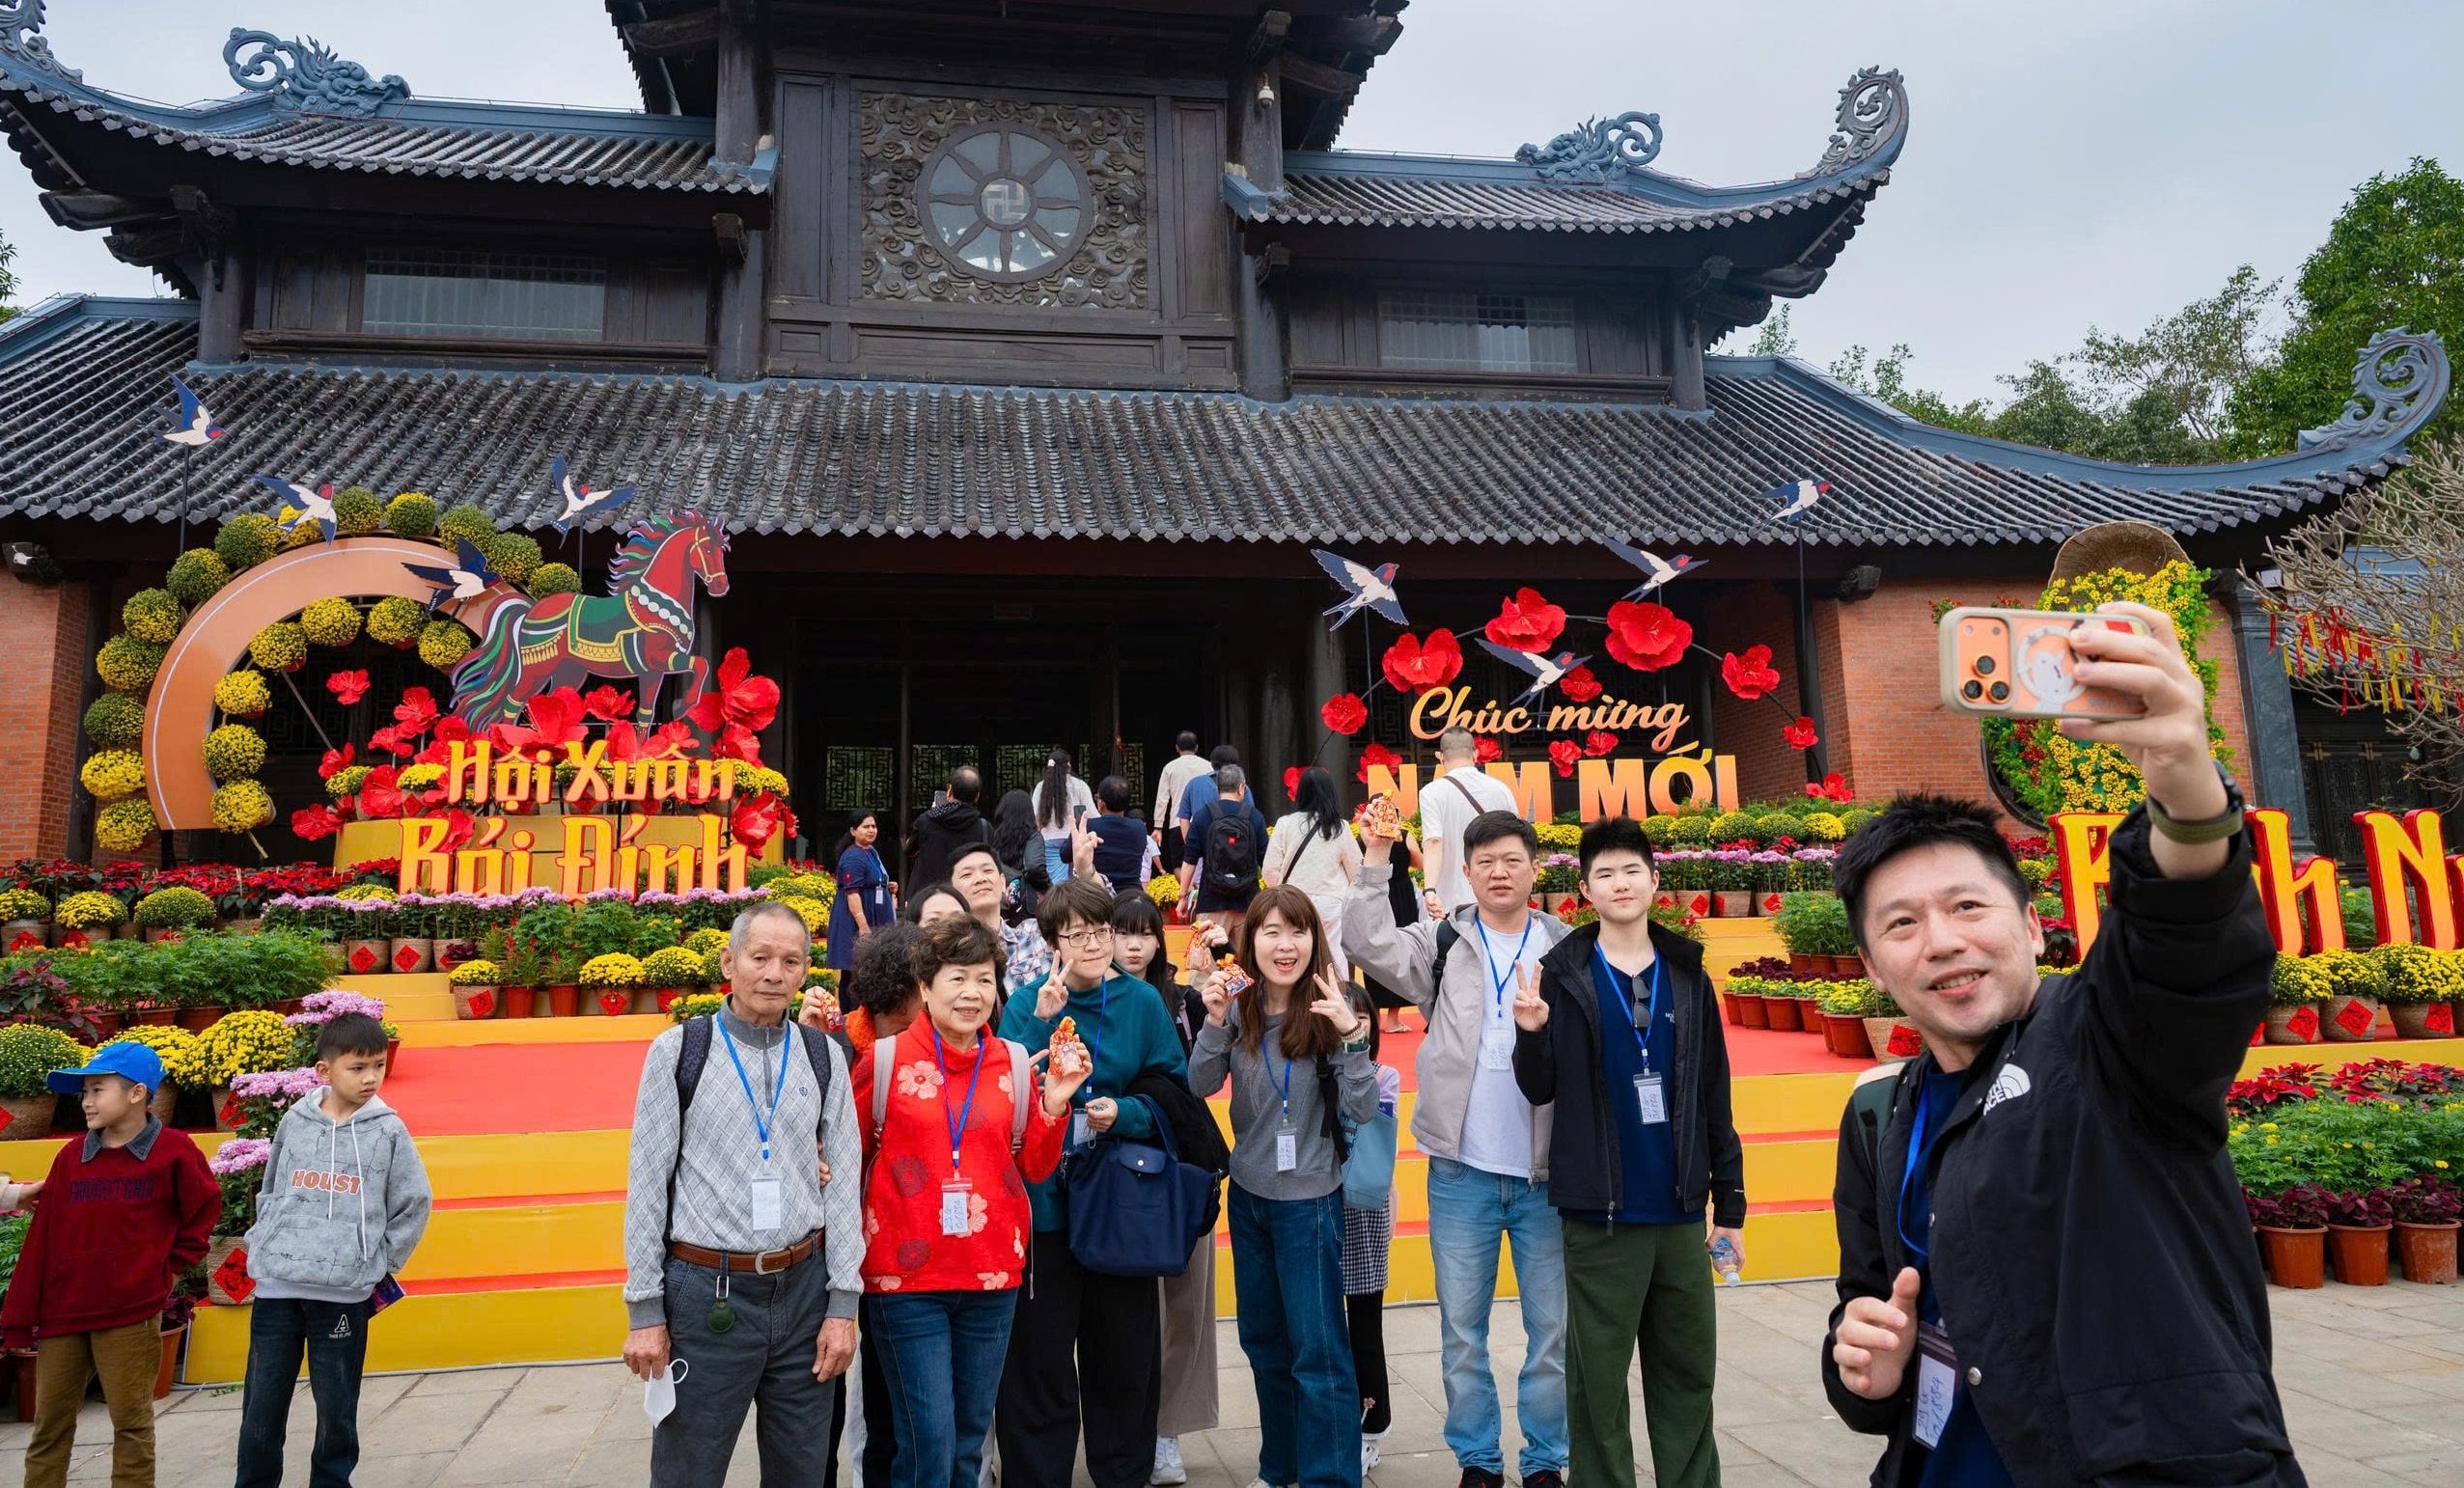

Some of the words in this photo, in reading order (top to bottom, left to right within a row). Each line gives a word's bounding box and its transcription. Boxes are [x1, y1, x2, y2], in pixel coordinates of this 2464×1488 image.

[1409, 686, 1533, 740] Chúc
[1546, 695, 1690, 753] mừng
[448, 740, 553, 812] Hội
[564, 740, 735, 803] Xuân
[1578, 741, 1739, 823] MỚI
[399, 815, 536, 898] Bái
[554, 813, 748, 903] Đính
